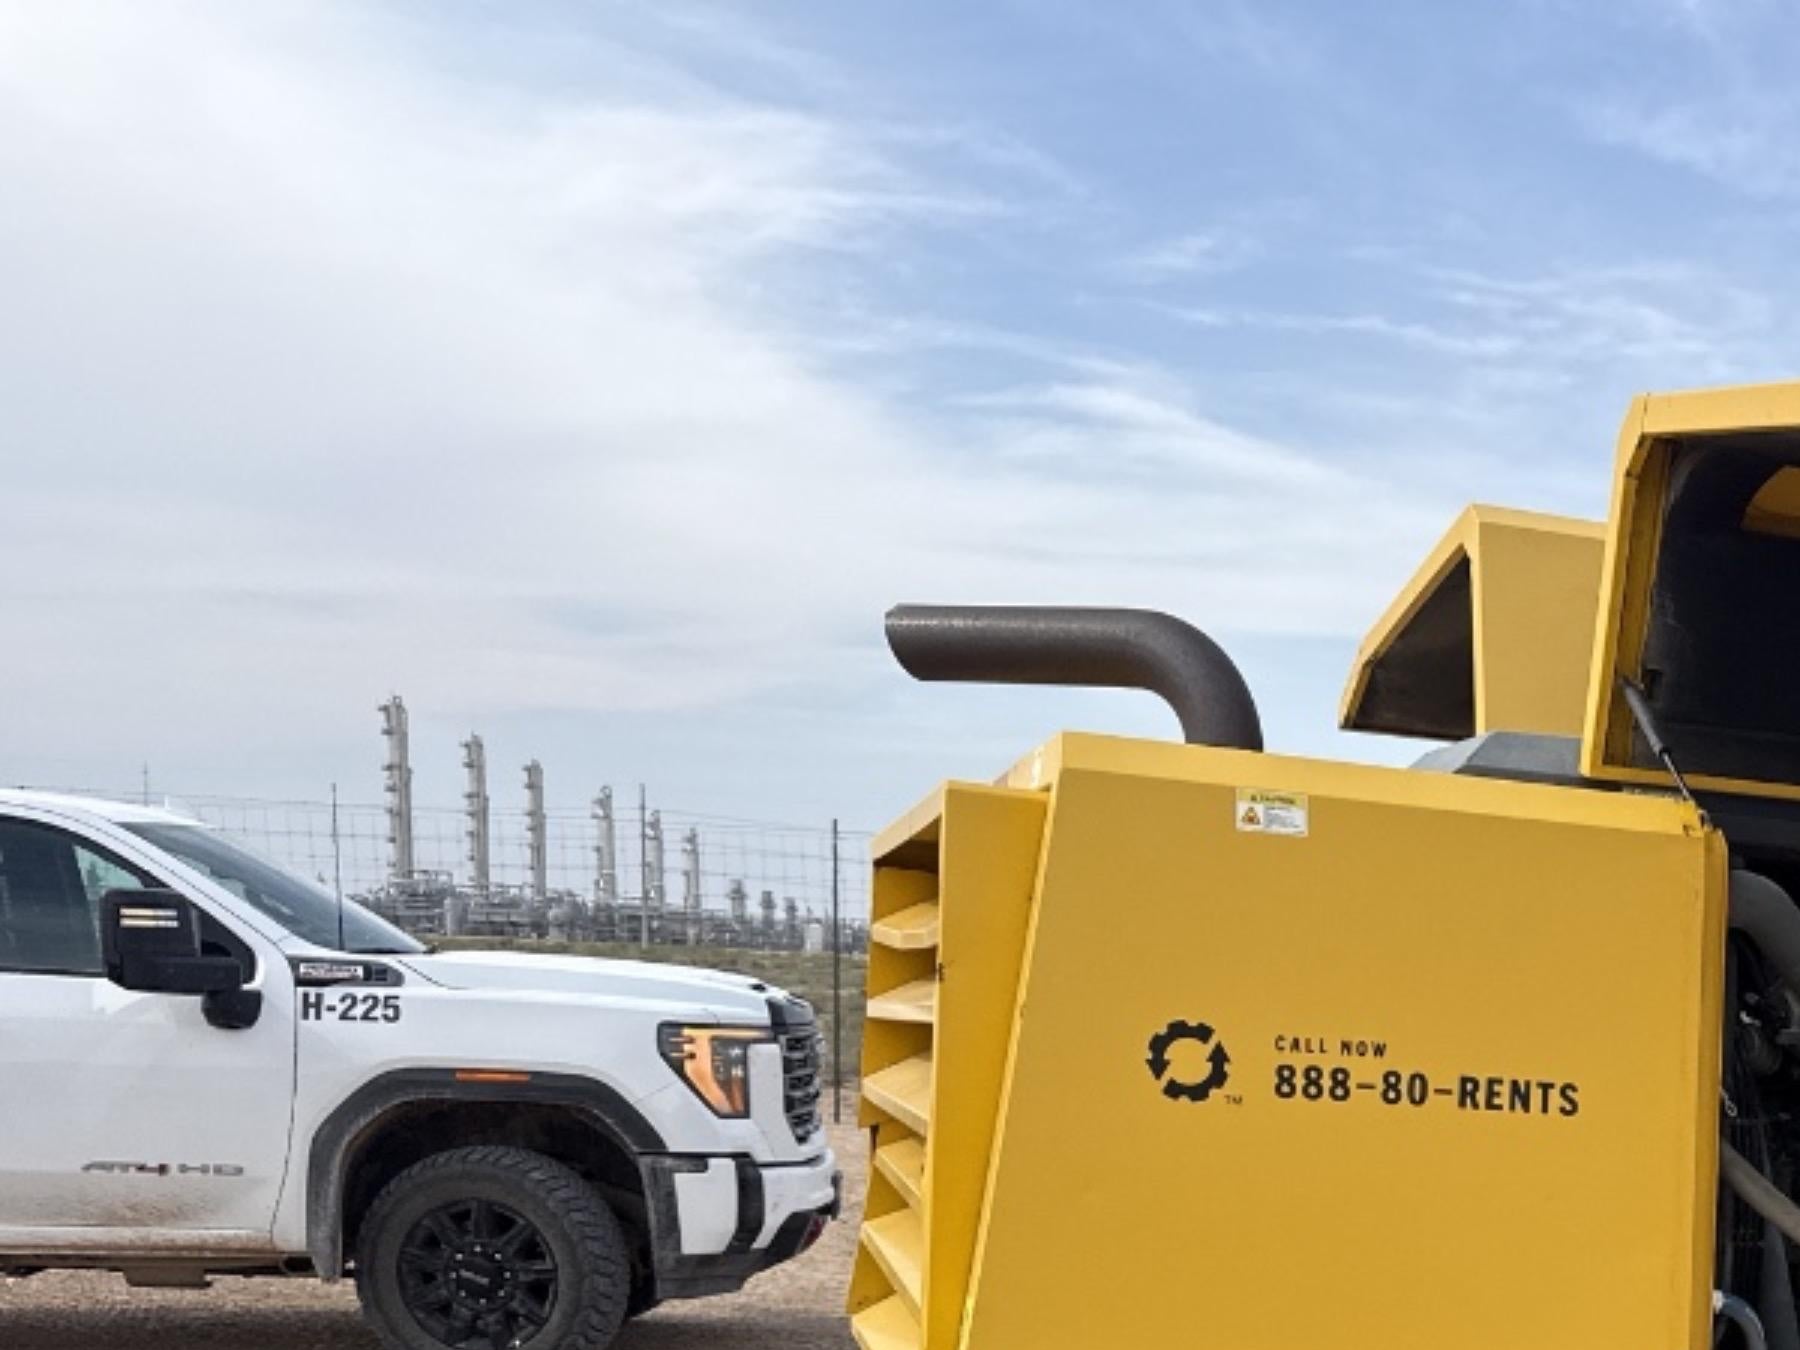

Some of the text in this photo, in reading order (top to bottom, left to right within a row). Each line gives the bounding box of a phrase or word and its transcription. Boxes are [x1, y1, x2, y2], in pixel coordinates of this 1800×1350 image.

[302, 992, 401, 1024] H-225
[1274, 1034, 1388, 1058] CALL NOW
[1274, 1064, 1580, 1117] 888-80-RENTS
